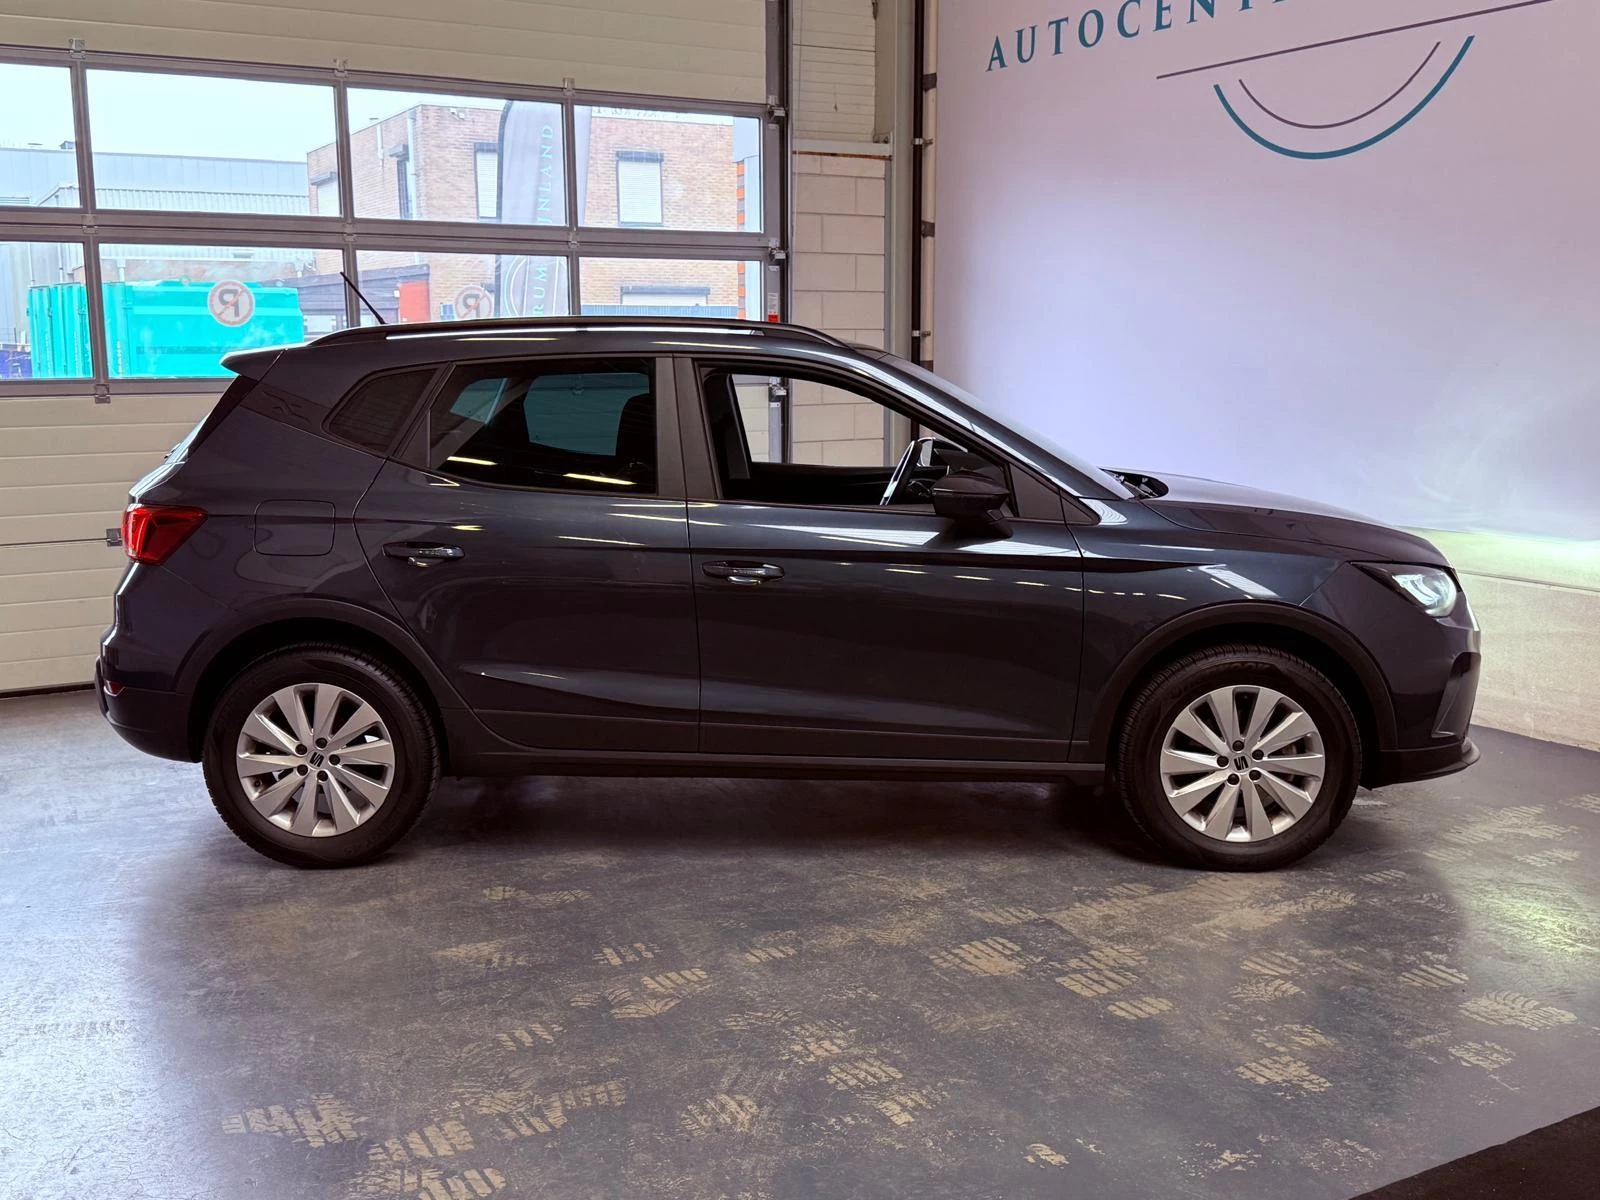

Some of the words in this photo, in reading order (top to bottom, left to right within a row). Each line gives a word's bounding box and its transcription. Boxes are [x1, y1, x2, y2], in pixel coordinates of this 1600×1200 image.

[985, 0, 1288, 72] AUTOCEN
[537, 124, 553, 223] JNLAND
[533, 265, 548, 317] RUM
